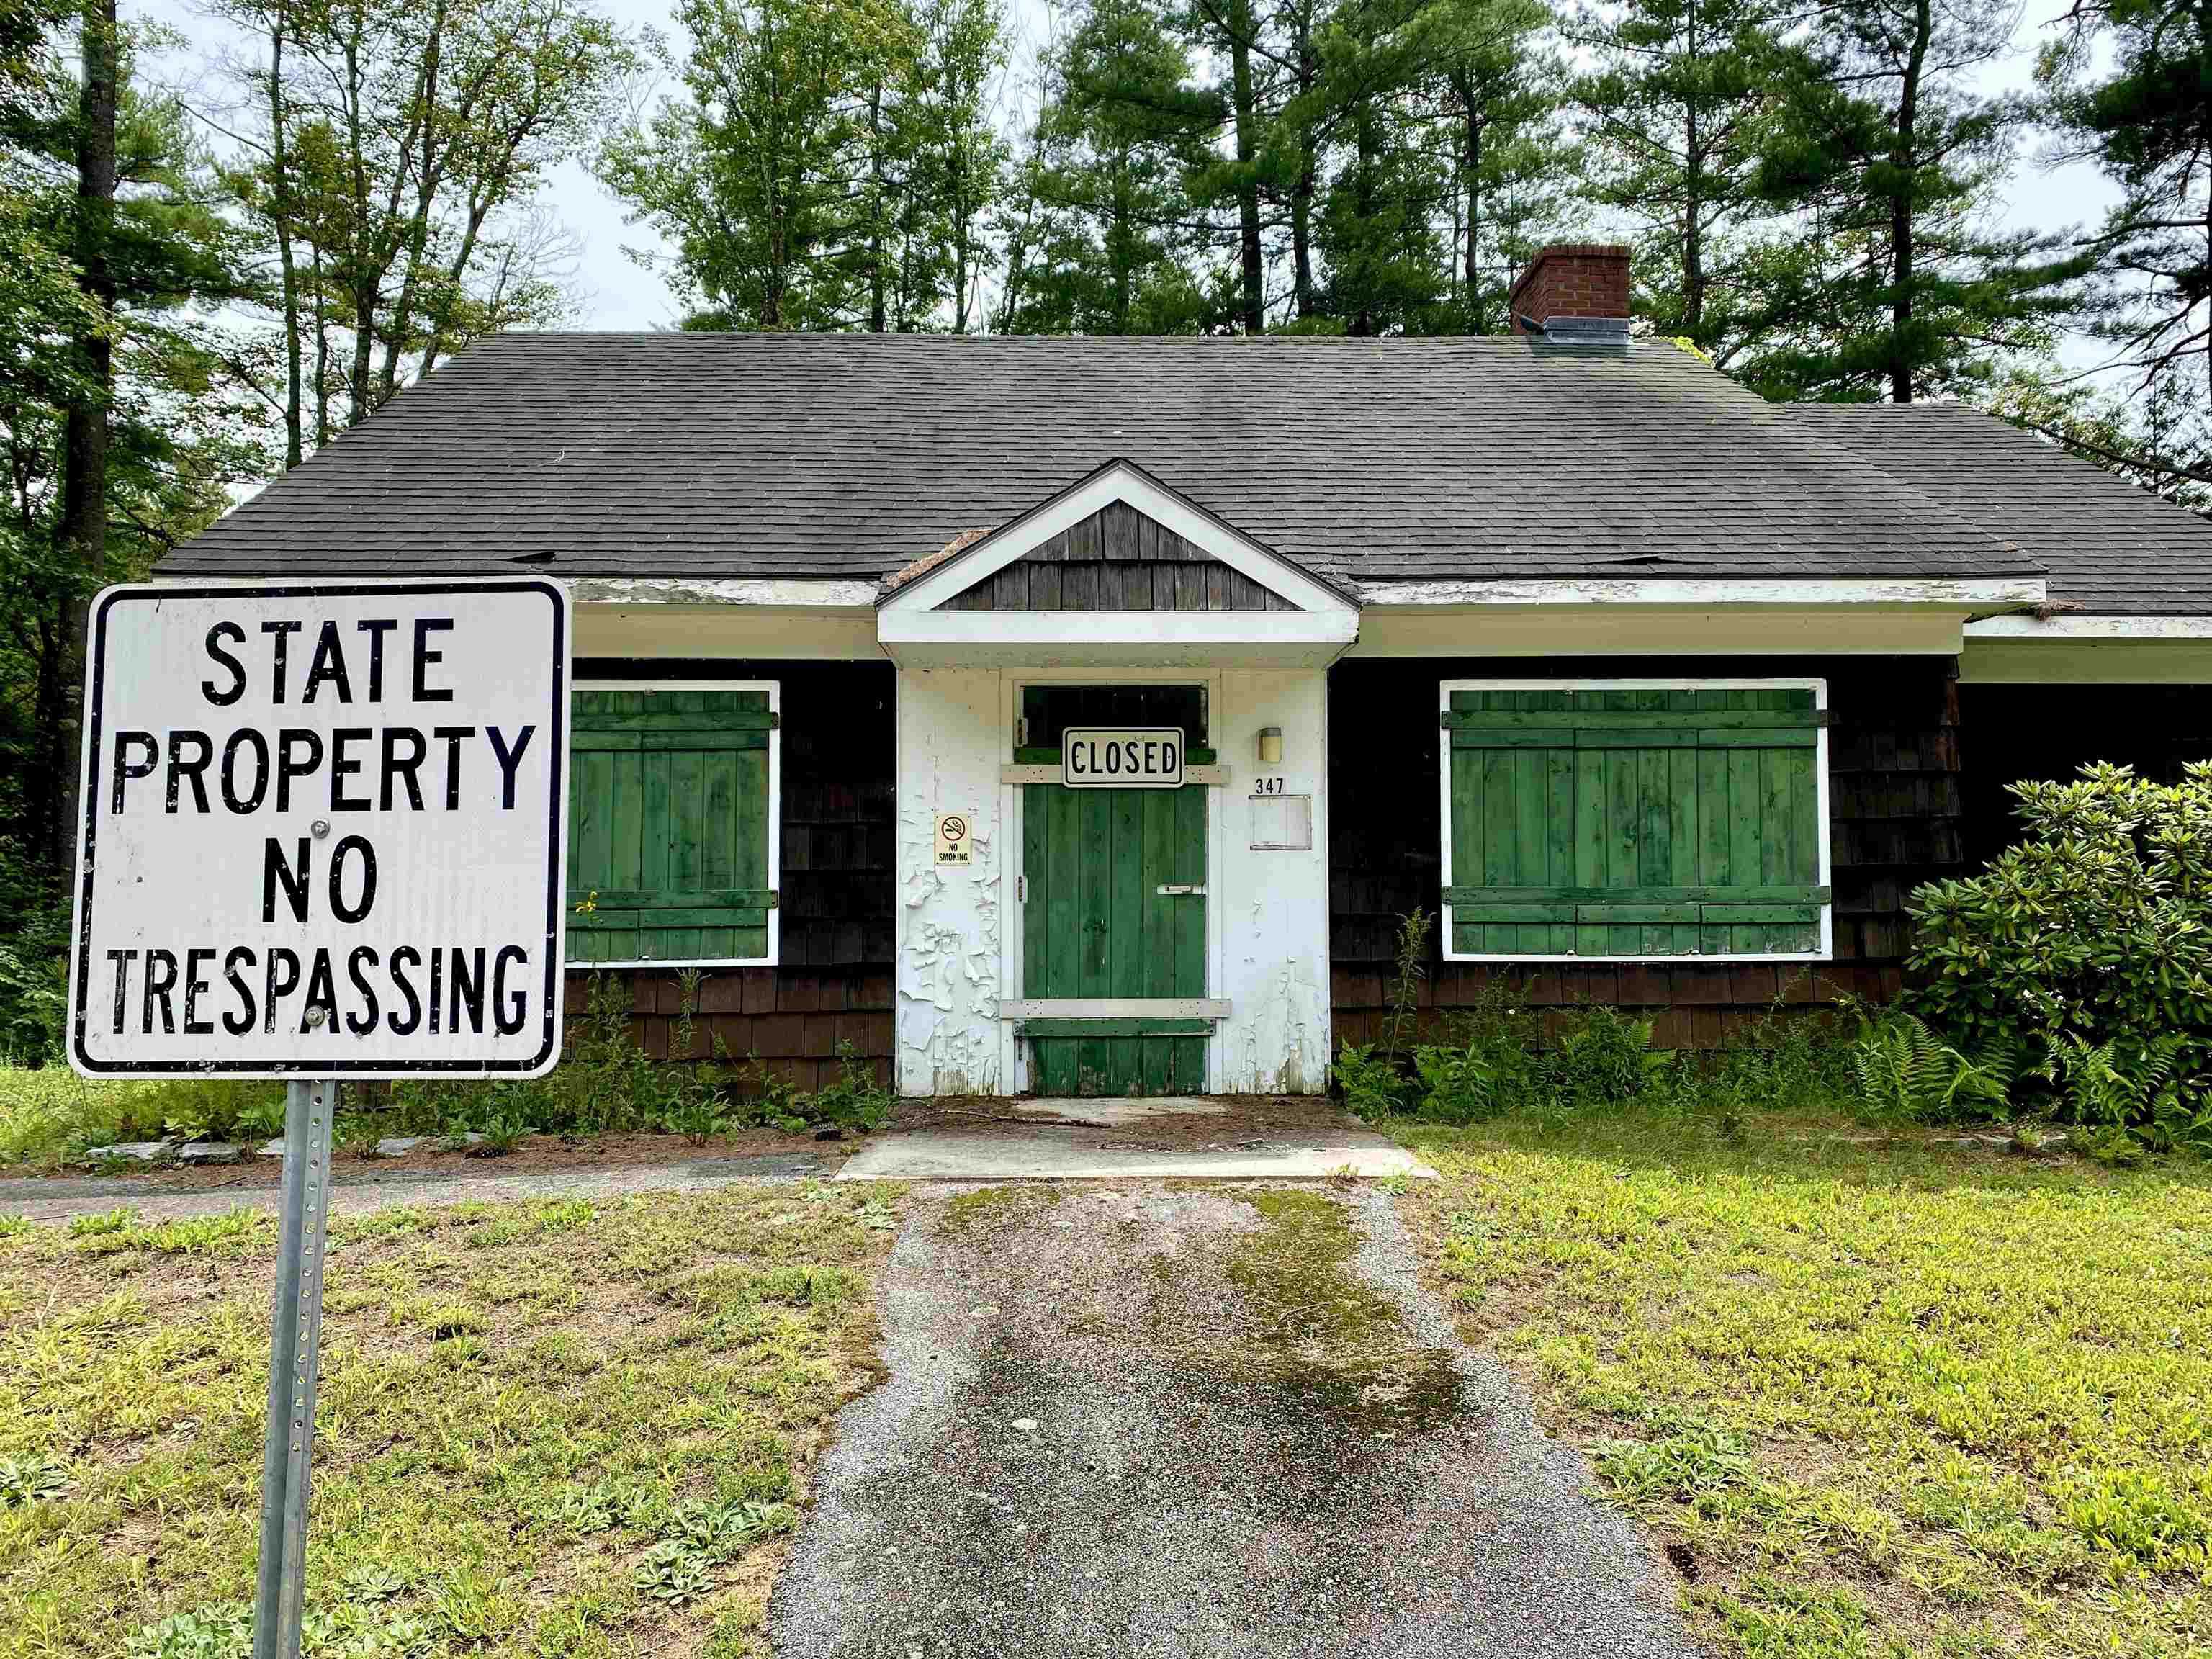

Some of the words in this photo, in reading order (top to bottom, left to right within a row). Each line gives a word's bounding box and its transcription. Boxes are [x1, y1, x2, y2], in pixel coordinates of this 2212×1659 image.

[201, 618, 454, 706] STATE
[111, 725, 536, 815] PROPERTY
[1071, 741, 1177, 774] CLOSED
[1256, 778, 1283, 794] 347
[938, 853, 968, 861] SMOKING
[948, 843, 958, 852] NO
[261, 835, 377, 925] NO
[107, 945, 528, 1037] TRESPASSING
